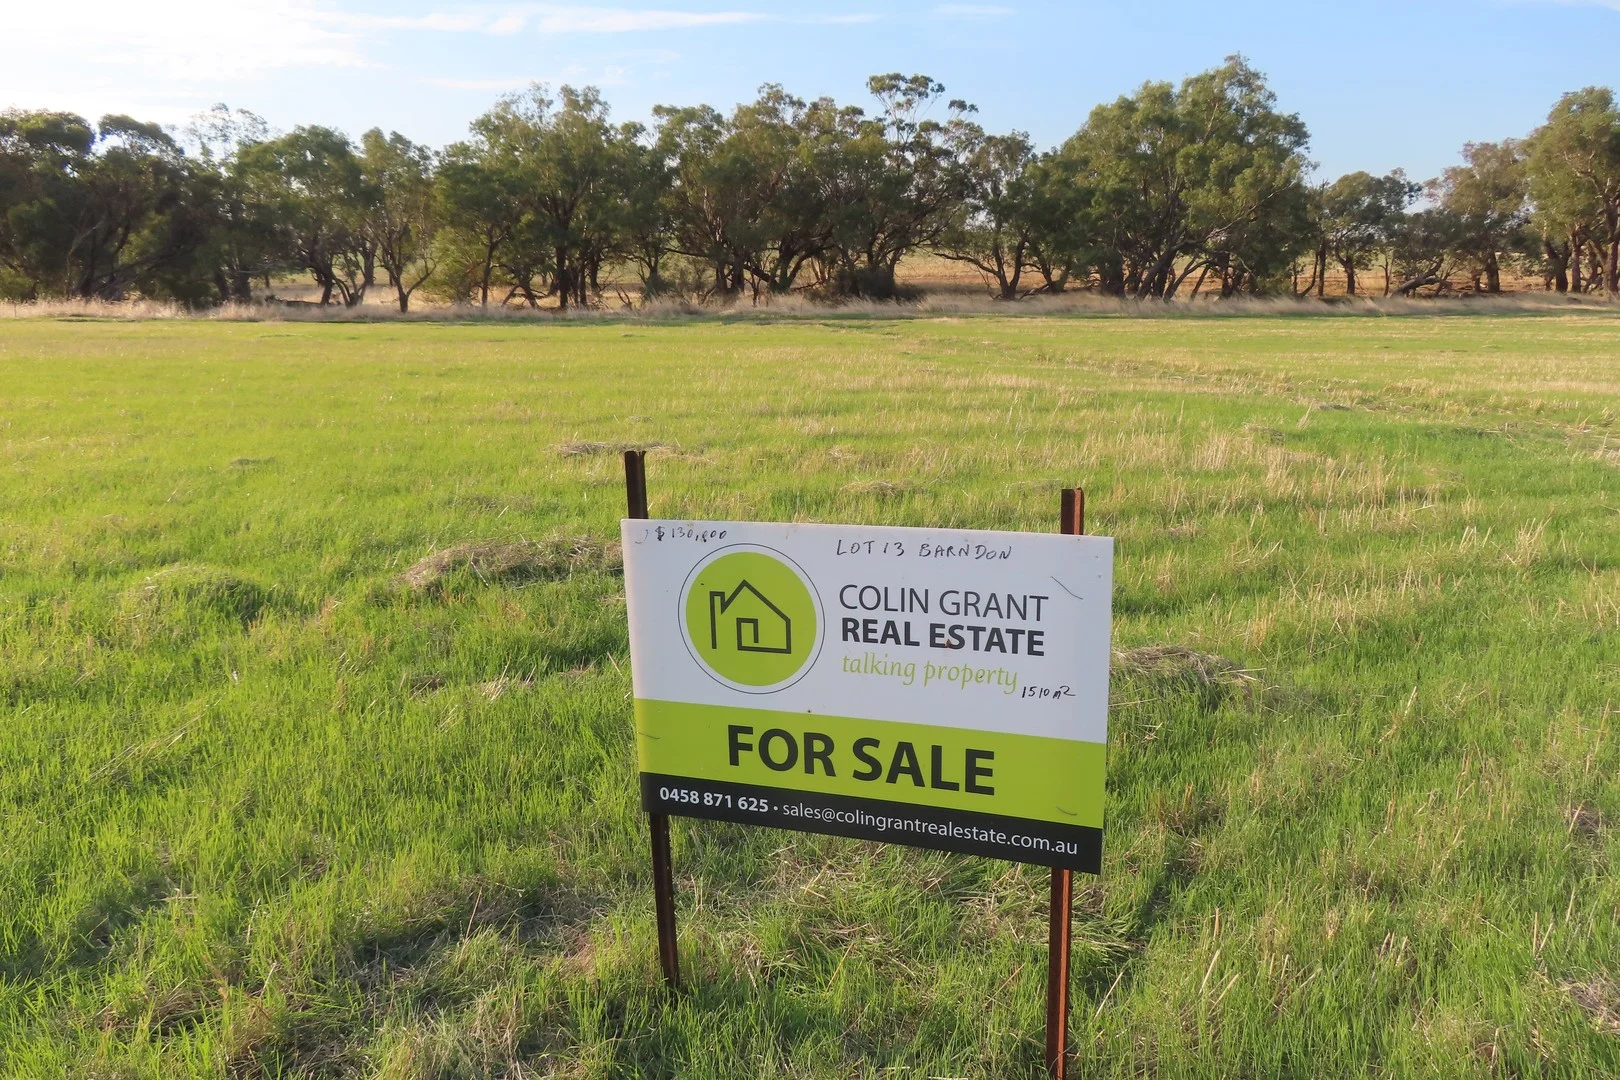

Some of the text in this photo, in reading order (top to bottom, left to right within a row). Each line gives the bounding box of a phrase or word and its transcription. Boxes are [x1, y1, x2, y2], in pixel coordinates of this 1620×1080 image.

[836, 539, 875, 556] LOT
[883, 542, 905, 556] 13
[839, 584, 1049, 622] COLIN GRANT
[841, 617, 1045, 656] REAL ESTATE
[842, 652, 1018, 694] talking property
[728, 724, 995, 796] FOR SALE
[659, 787, 1078, 855] 0458 871 625 sales@colingrantrealestate.com.au
